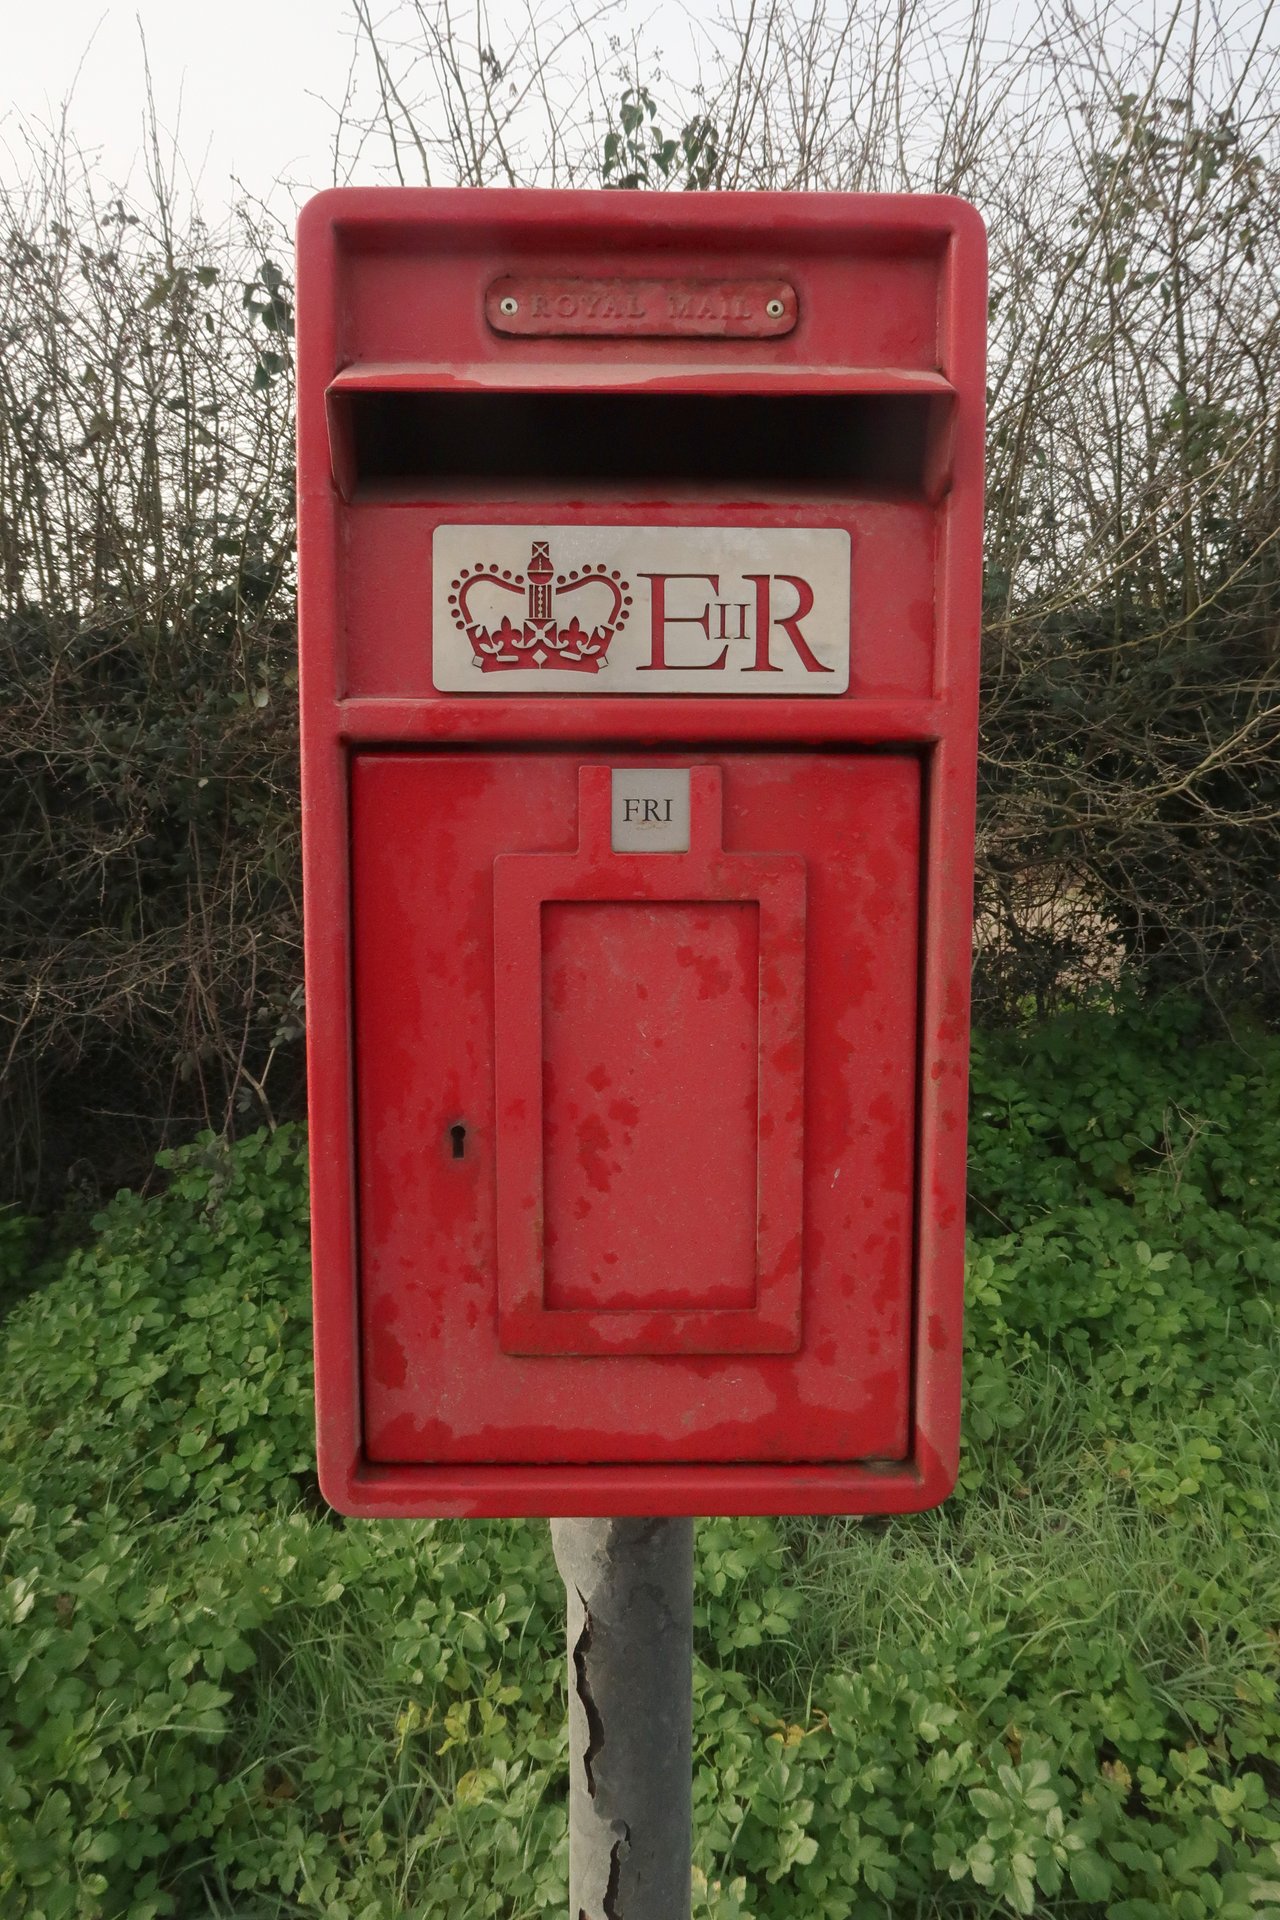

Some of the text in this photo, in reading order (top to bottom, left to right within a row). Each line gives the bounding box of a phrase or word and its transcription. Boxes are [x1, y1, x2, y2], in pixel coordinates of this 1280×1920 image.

[531, 295, 753, 321] ROYAL MAIL
[622, 798, 674, 822] FRI
